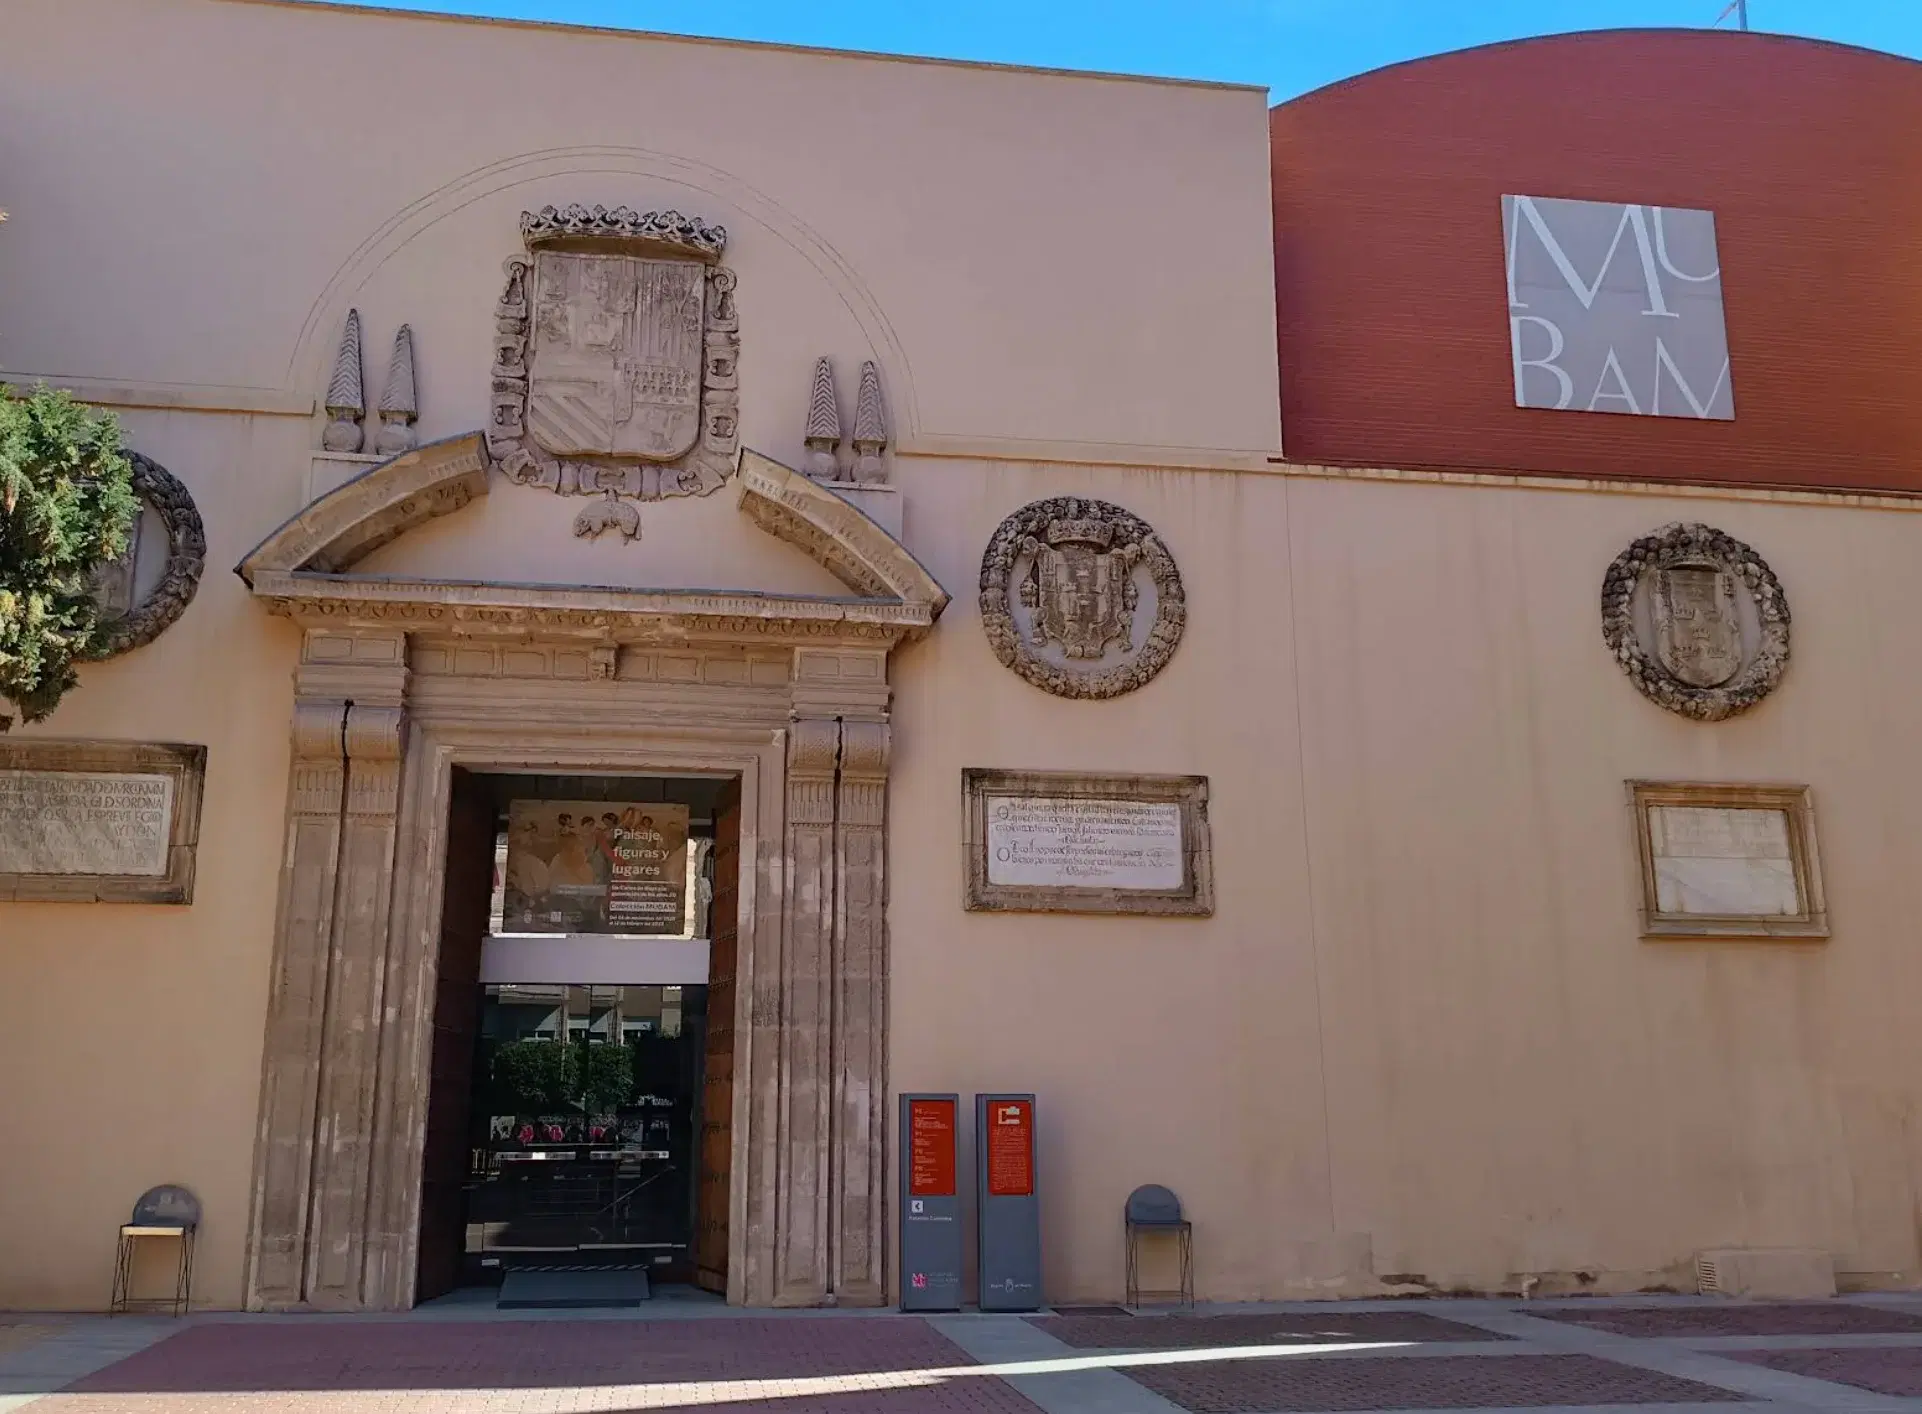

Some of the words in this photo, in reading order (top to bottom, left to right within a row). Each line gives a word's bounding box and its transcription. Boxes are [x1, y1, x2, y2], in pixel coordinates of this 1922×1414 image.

[613, 828, 664, 843] Paisaje,
[612, 846, 659, 860] figuras
[661, 849, 670, 861] y
[611, 863, 661, 877] lugares
